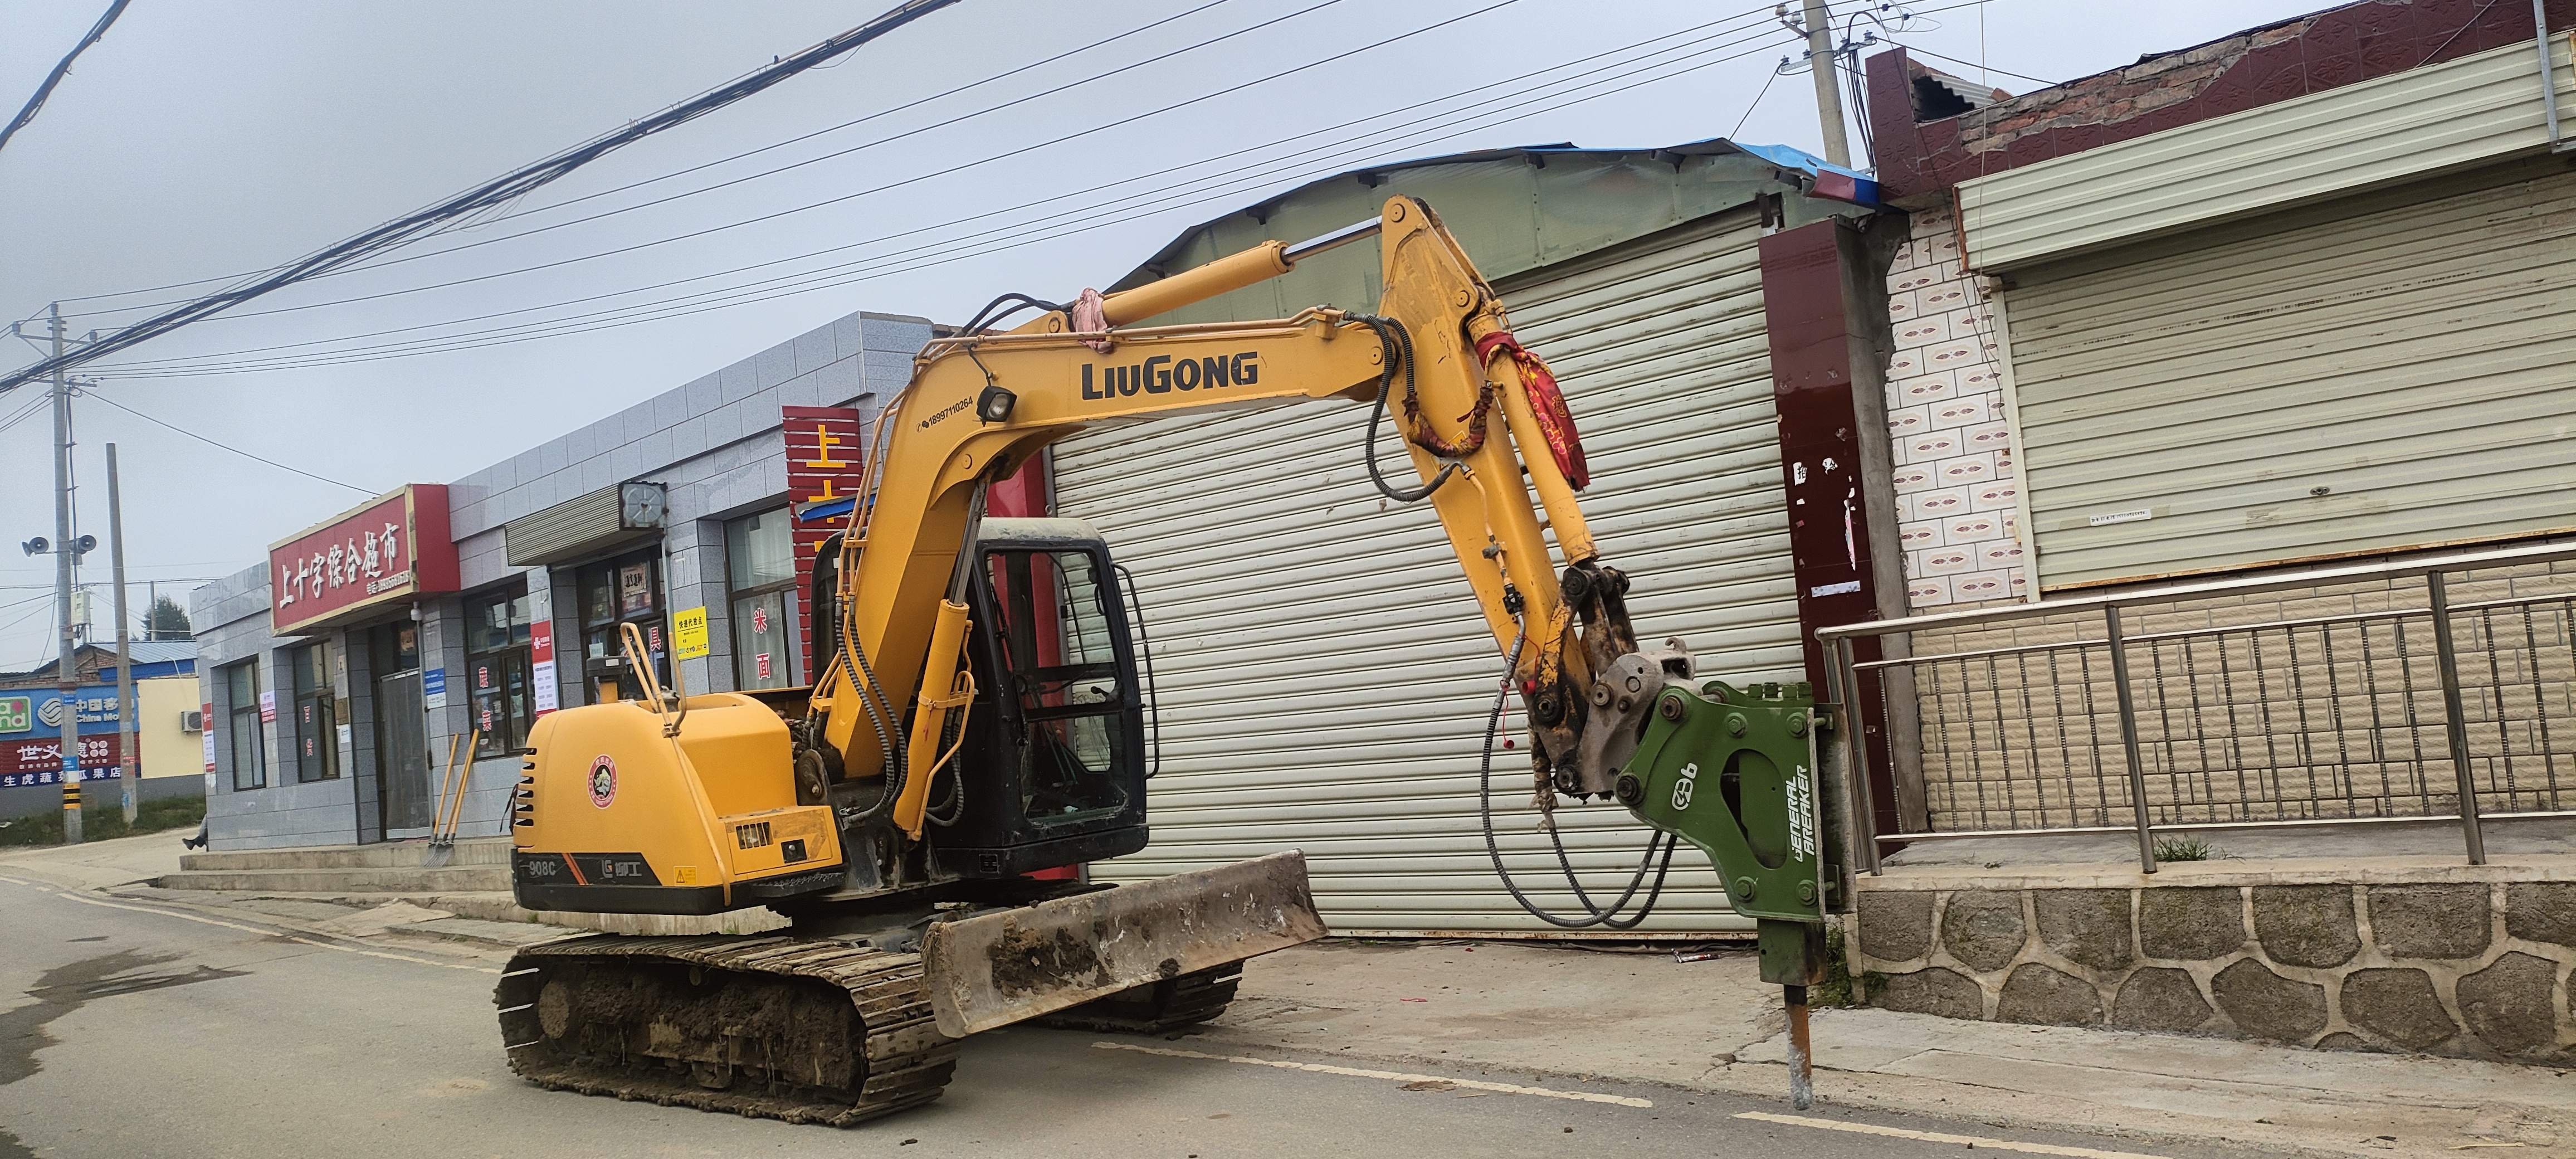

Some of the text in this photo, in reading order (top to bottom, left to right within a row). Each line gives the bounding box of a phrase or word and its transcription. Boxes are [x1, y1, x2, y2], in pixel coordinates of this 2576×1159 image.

[929, 396, 973, 426] 18997110264
[280, 523, 399, 609] 上十字综合超市
[76, 698, 134, 712] 中国移
[1786, 776, 1803, 863] GENERAL
[1797, 765, 1814, 855] BREAKER
[530, 861, 556, 875] 908C
